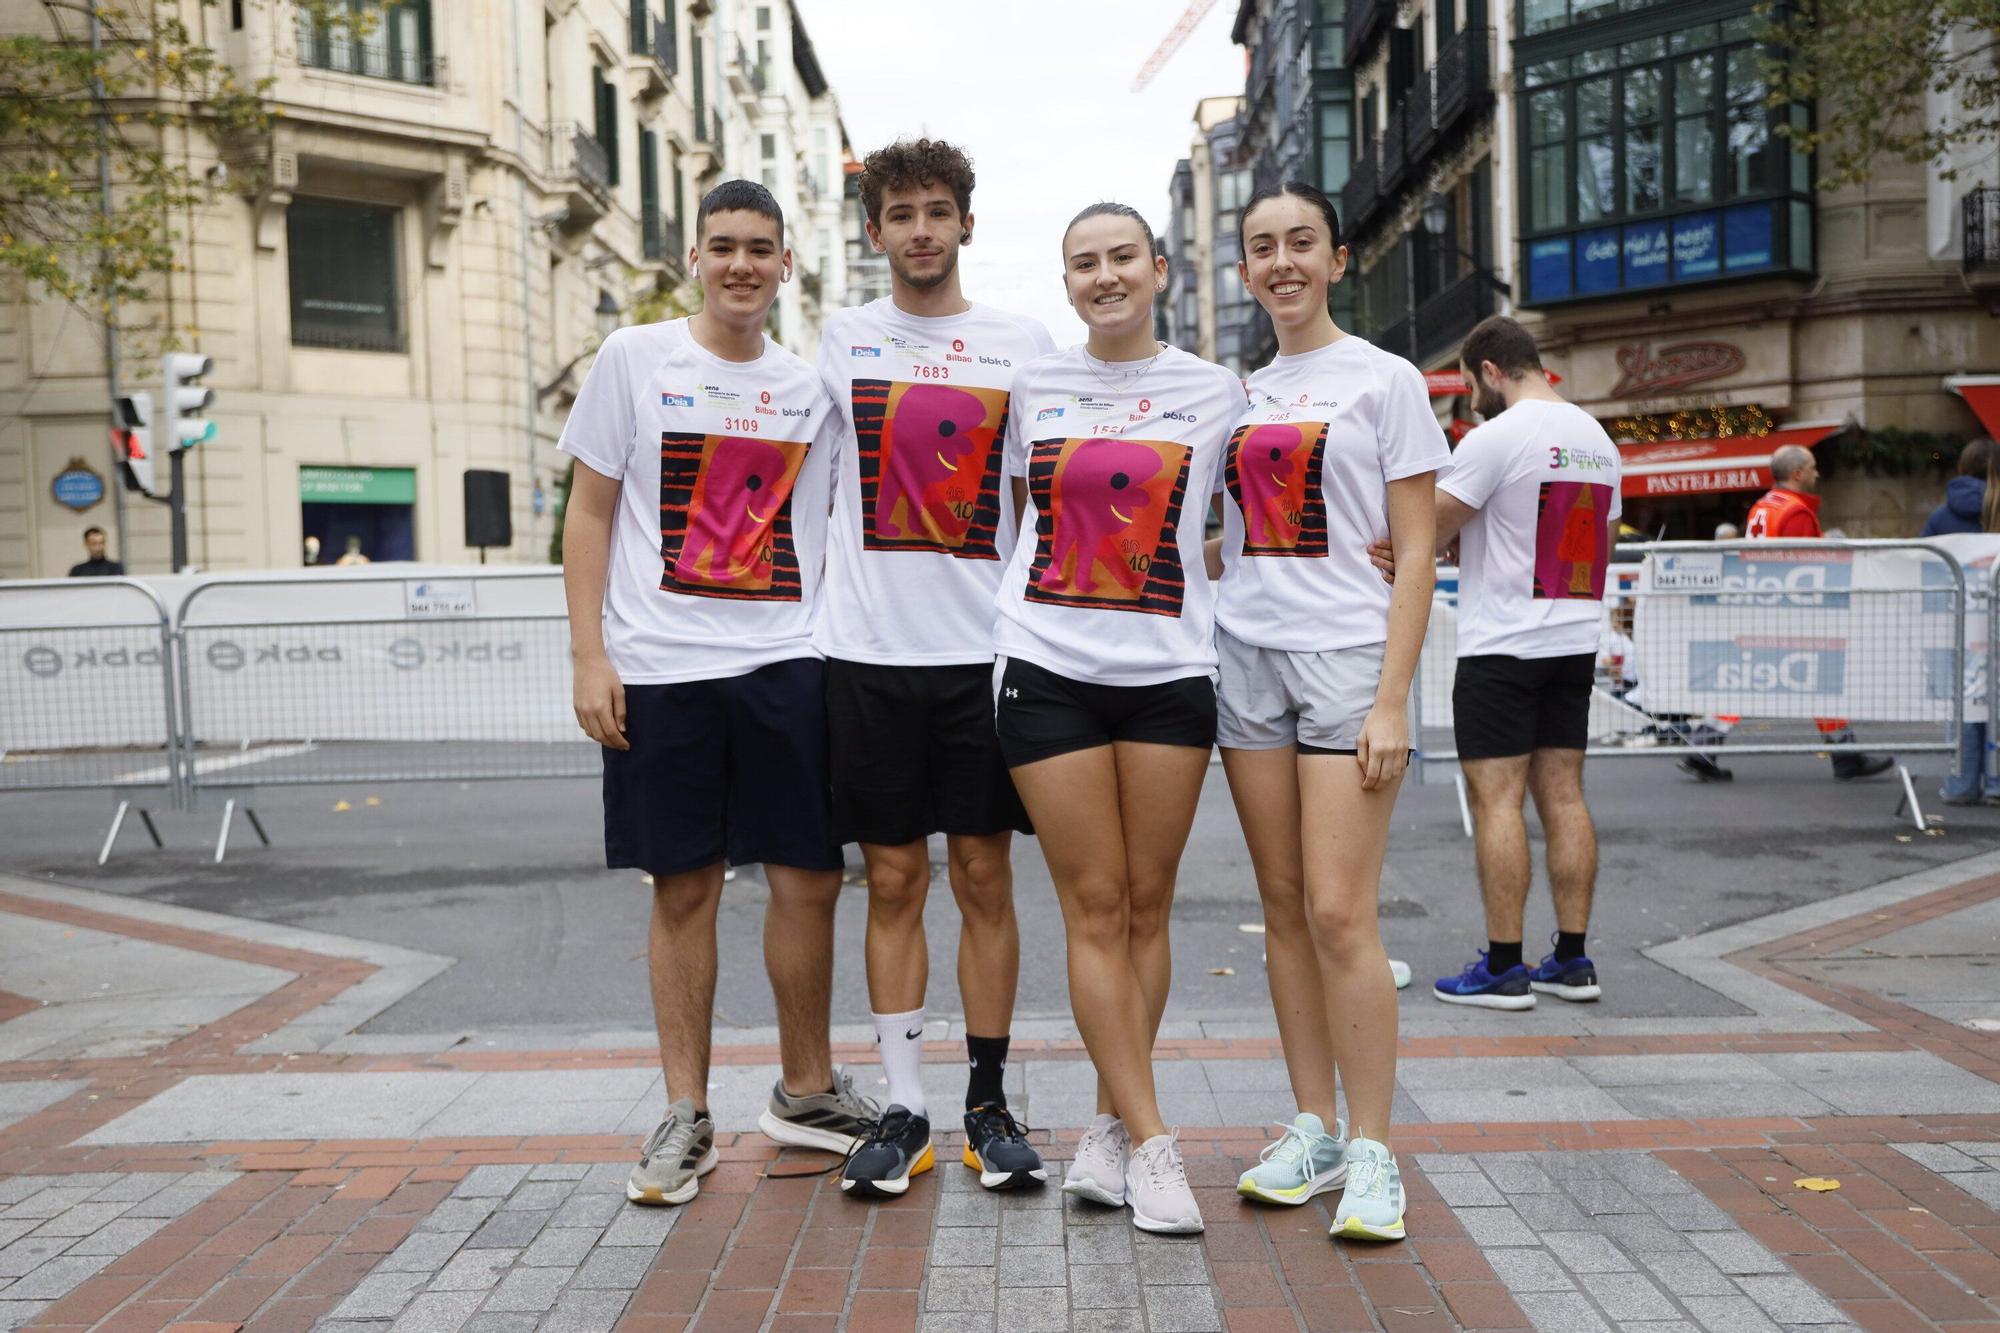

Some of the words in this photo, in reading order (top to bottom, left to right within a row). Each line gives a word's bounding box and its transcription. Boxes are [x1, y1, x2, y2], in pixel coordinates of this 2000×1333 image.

[855, 348, 876, 357] Deia
[946, 353, 972, 363] Bilbao
[978, 355, 1001, 366] bbk
[913, 365, 949, 379] 7683
[666, 396, 689, 407] Deia
[755, 405, 777, 416] Bilbao
[783, 408, 803, 417] bbk
[725, 417, 758, 432] 3109
[1549, 447, 1569, 469] 36
[1647, 469, 1760, 493] PASTELERIA
